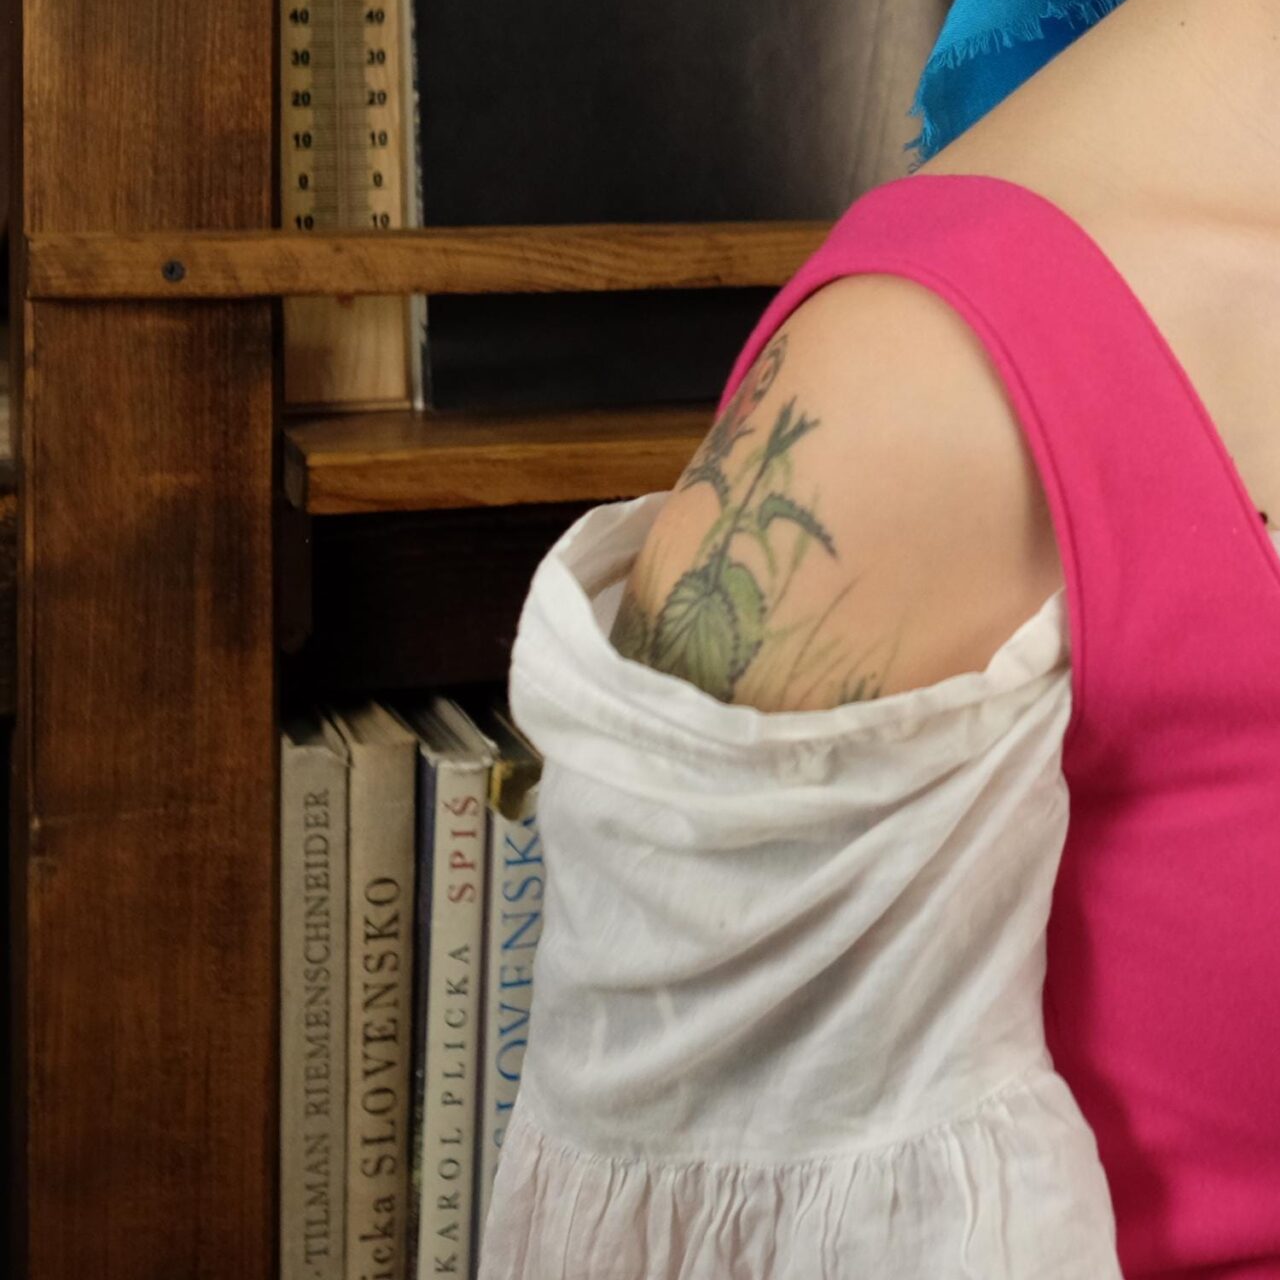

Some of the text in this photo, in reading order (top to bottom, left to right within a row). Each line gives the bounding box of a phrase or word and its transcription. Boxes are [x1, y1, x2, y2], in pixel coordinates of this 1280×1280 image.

[289, 8, 309, 24] 40
[365, 8, 385, 23] 40
[291, 49, 310, 66] 30
[367, 49, 386, 65] 30
[292, 91, 311, 107] 20
[368, 90, 387, 105] 20
[294, 132, 312, 149] 10
[370, 131, 388, 146] 10
[298, 173, 309, 190] 0
[373, 172, 383, 188] 0
[303, 789, 330, 1265] TILMAN RIEMENSCHNEIDER
[361, 877, 400, 1178] SLOVENSKO
[435, 795, 478, 1274] KAROL PLICKA SPIŠ
